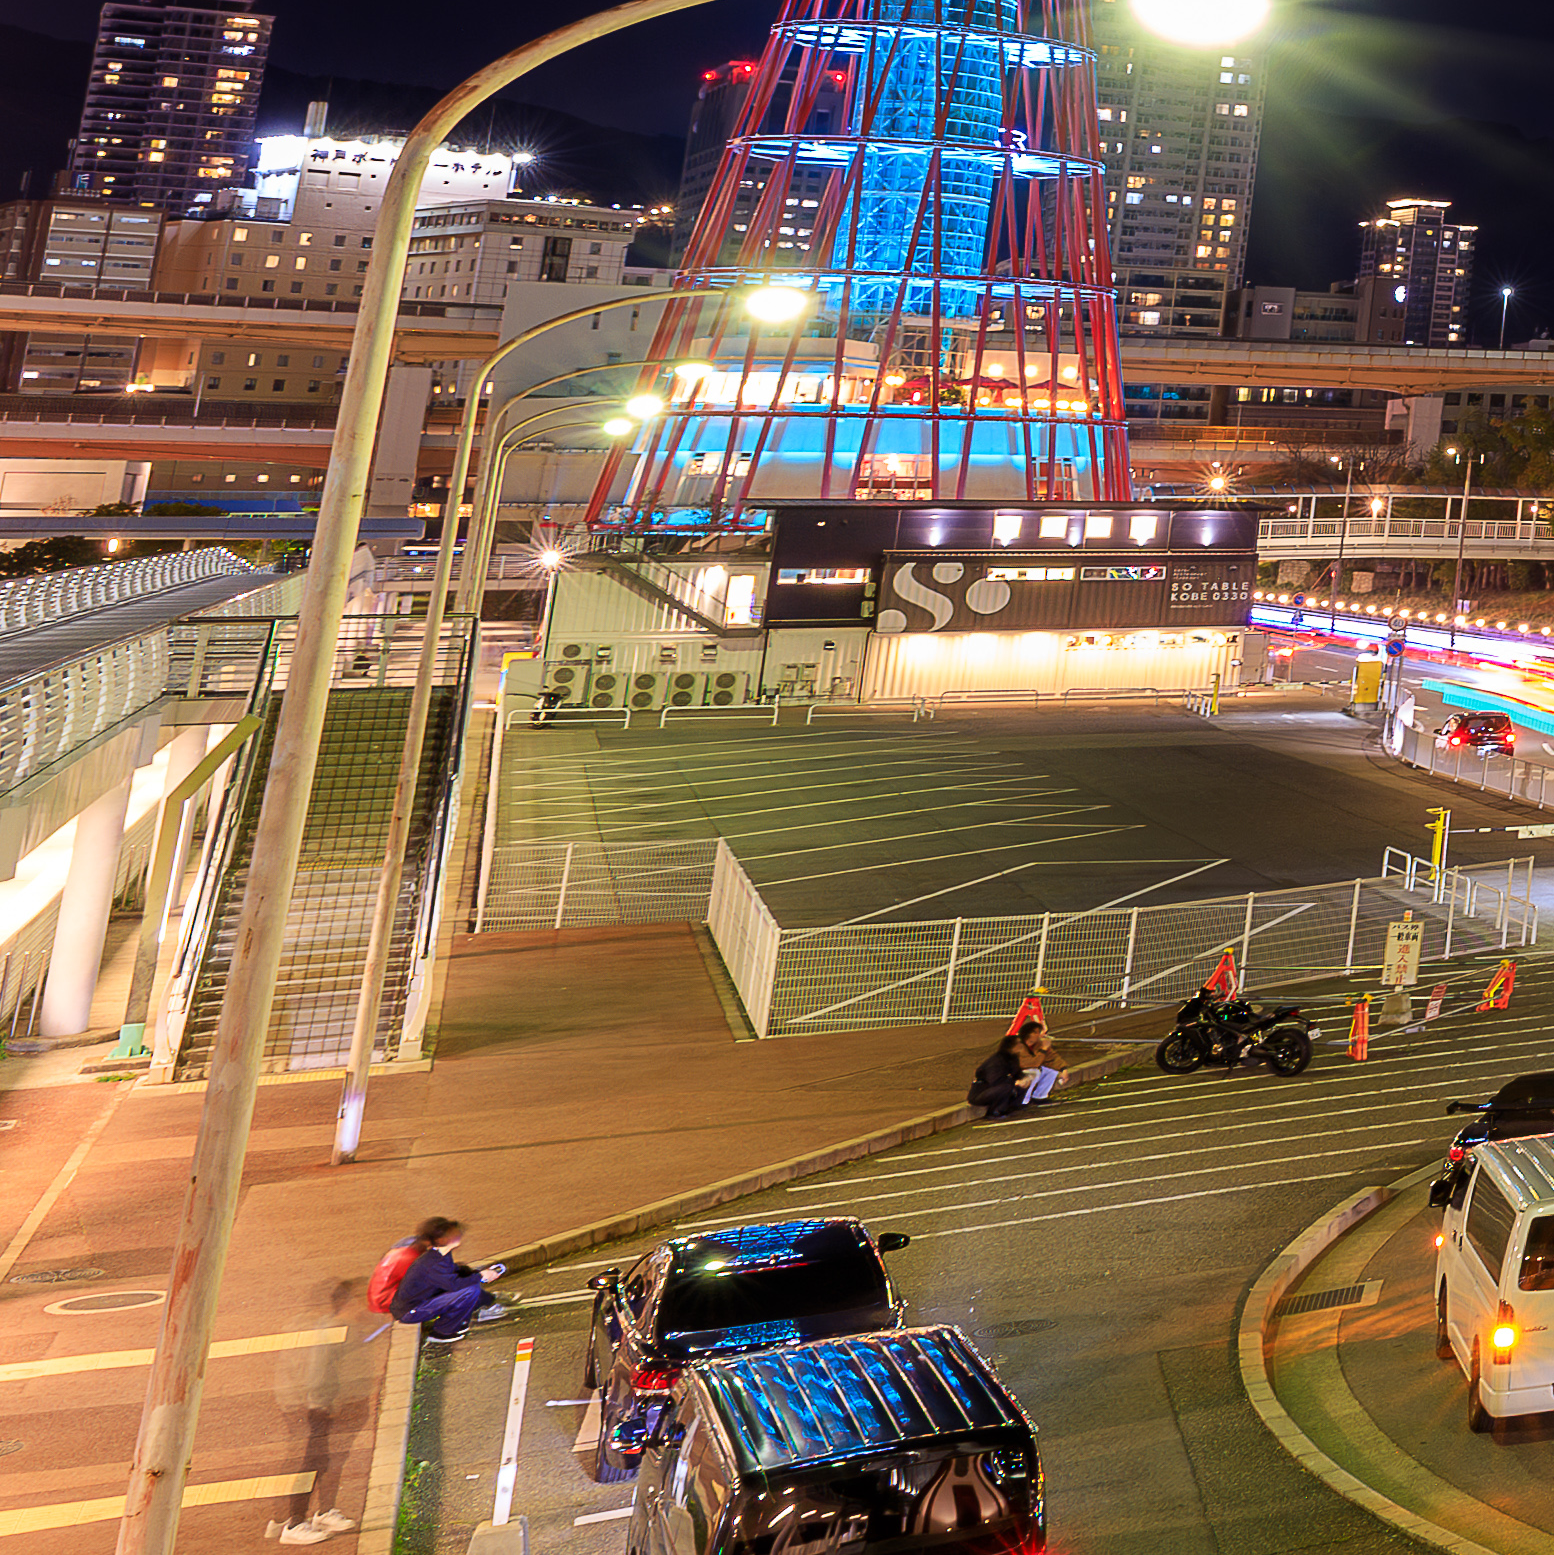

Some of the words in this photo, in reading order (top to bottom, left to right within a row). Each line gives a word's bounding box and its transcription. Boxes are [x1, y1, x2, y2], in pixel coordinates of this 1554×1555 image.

[310, 149, 503, 176] 神戸ポーーホテル
[1171, 582, 1193, 592] SO
[1201, 581, 1250, 591] TABLE
[1170, 591, 1208, 602] KOBE
[1393, 618, 1404, 627] 40
